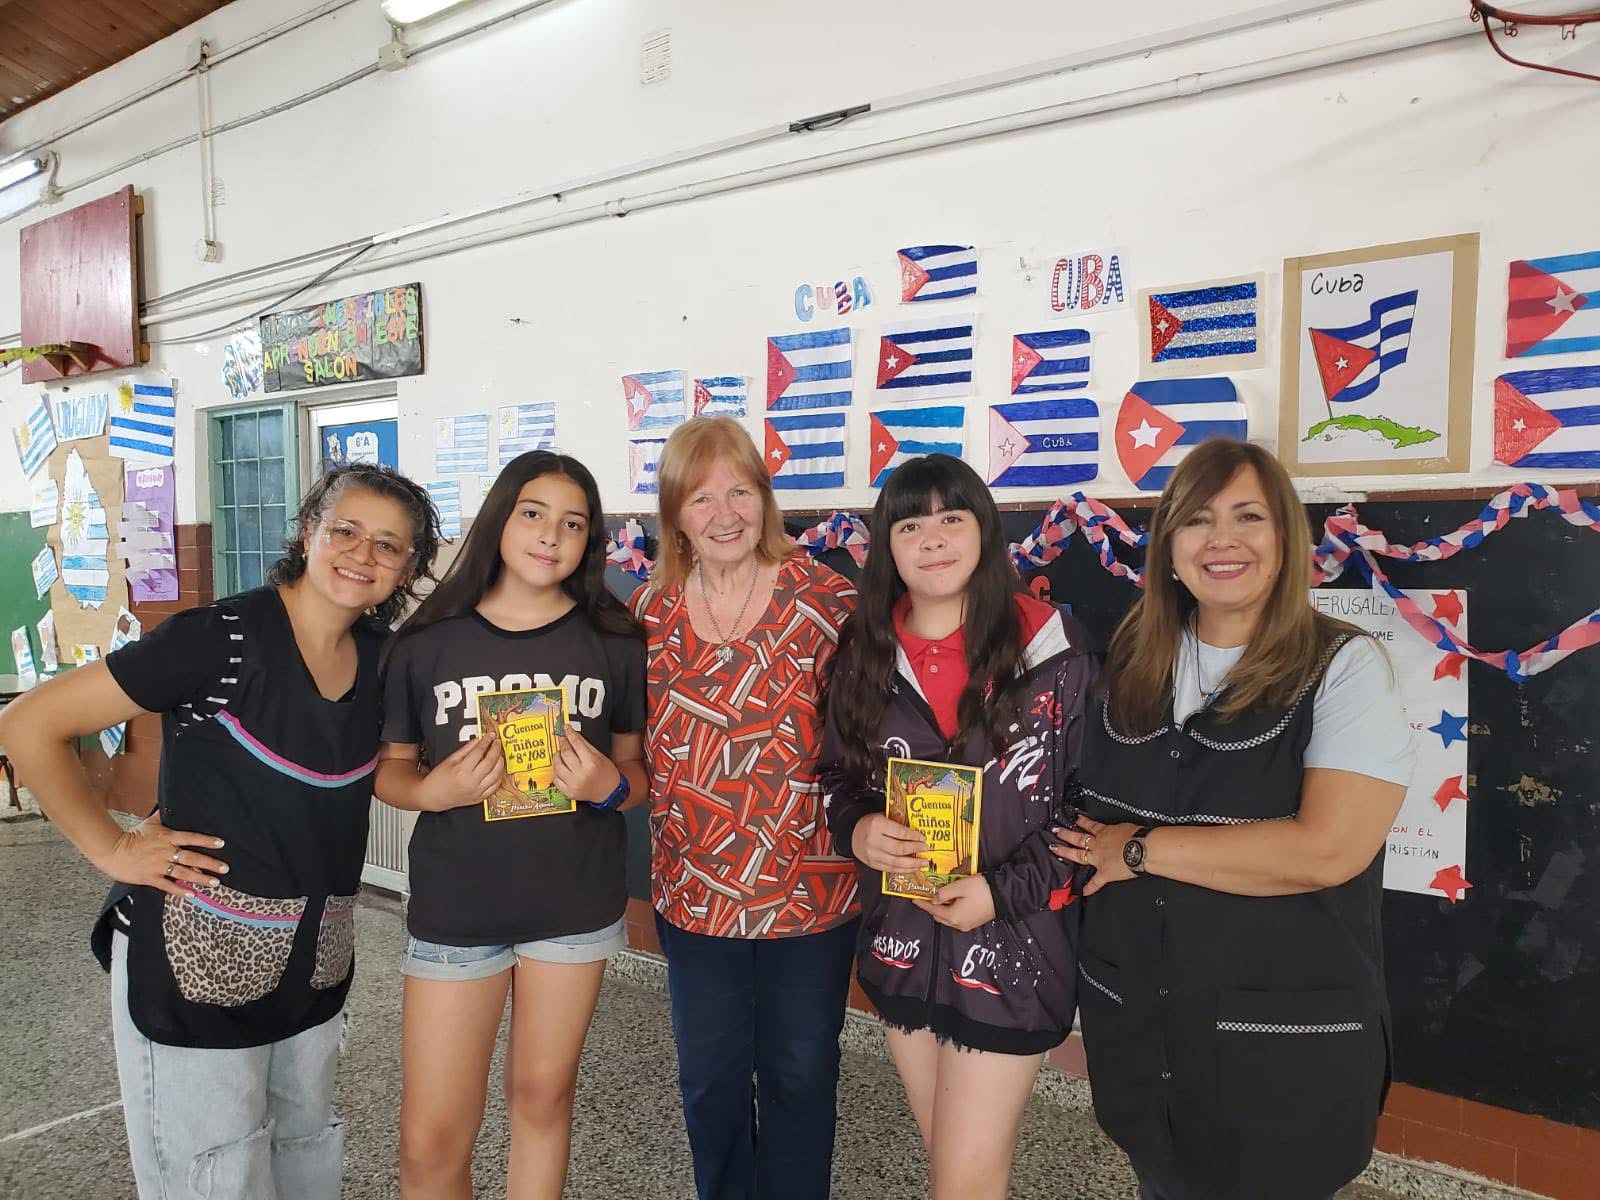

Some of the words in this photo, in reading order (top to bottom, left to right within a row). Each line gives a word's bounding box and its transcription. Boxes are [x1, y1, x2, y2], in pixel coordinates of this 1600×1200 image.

[1050, 254, 1124, 312] CUBA
[1310, 272, 1364, 295] Cuba
[794, 276, 873, 323] CUBA
[303, 351, 358, 384] SALÓN
[1042, 436, 1073, 449] CUBA
[1312, 591, 1396, 616] JERUSALE
[502, 722, 544, 739] Cuentos
[513, 738, 545, 753] niños
[528, 747, 546, 762] 108
[909, 796, 952, 813] Cuentos
[918, 815, 951, 829] niños
[932, 829, 951, 842] 108
[1417, 827, 1433, 837] EL
[873, 934, 921, 960] RESADOS
